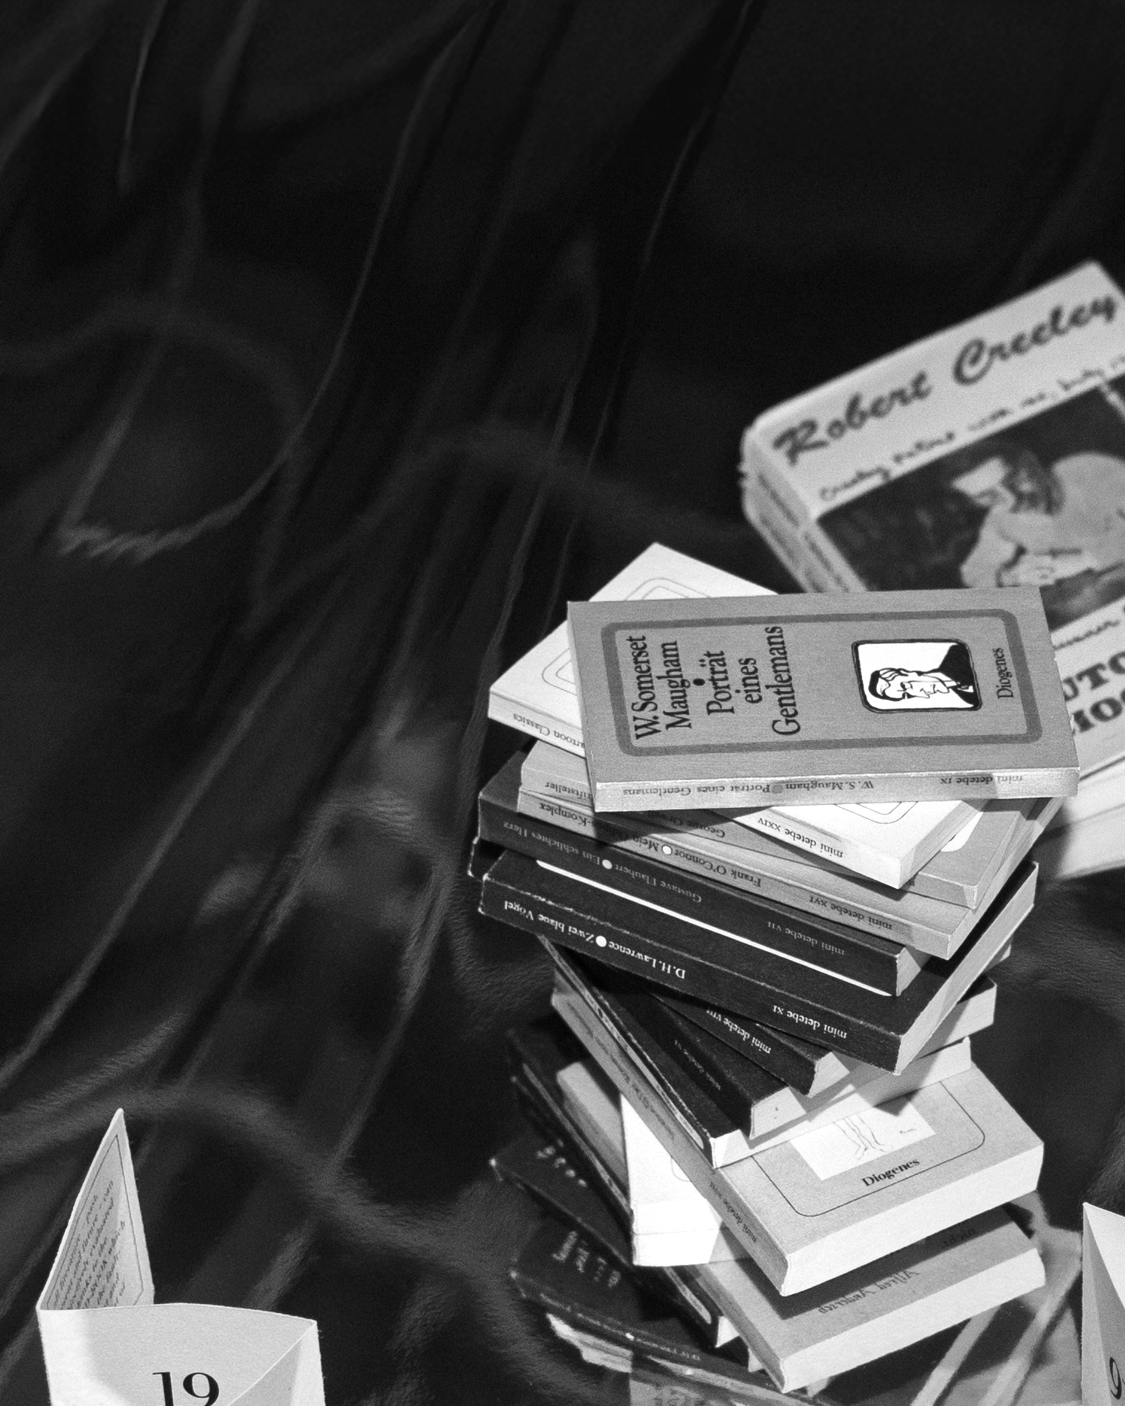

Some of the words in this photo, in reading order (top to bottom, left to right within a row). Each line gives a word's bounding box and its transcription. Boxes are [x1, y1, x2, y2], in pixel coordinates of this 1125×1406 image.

[772, 371, 931, 467] Robert
[953, 295, 1117, 385] Creeley
[699, 651, 735, 715] Porträt
[735, 658, 763, 704] eines
[765, 626, 801, 736] Gentlemans
[996, 647, 1015, 700] Diogenes
[656, 640, 692, 730] Maugham
[512, 712, 551, 737] Classics
[956, 775, 993, 785] detebe
[997, 774, 1024, 783] mini
[623, 785, 691, 798] Gentlemans
[697, 785, 726, 794] eines
[731, 784, 771, 794] Porträt
[686, 819, 726, 839] George
[757, 817, 782, 833] xxiv
[784, 827, 817, 849] detebe
[820, 843, 844, 859] mini
[674, 849, 727, 876] O'Connor
[730, 869, 762, 888] Frank
[503, 900, 535, 921] Vögel
[831, 904, 865, 922] detebe
[537, 913, 566, 934] blaue
[868, 916, 894, 932] mini
[567, 925, 596, 944] Zwei
[784, 927, 819, 946] detebe
[821, 942, 846, 956] mini
[723, 1016, 751, 1041] detebe
[787, 1010, 822, 1031] detebe
[823, 1023, 848, 1040] mini
[751, 1036, 772, 1054] mini
[861, 1158, 920, 1187] Diogenes
